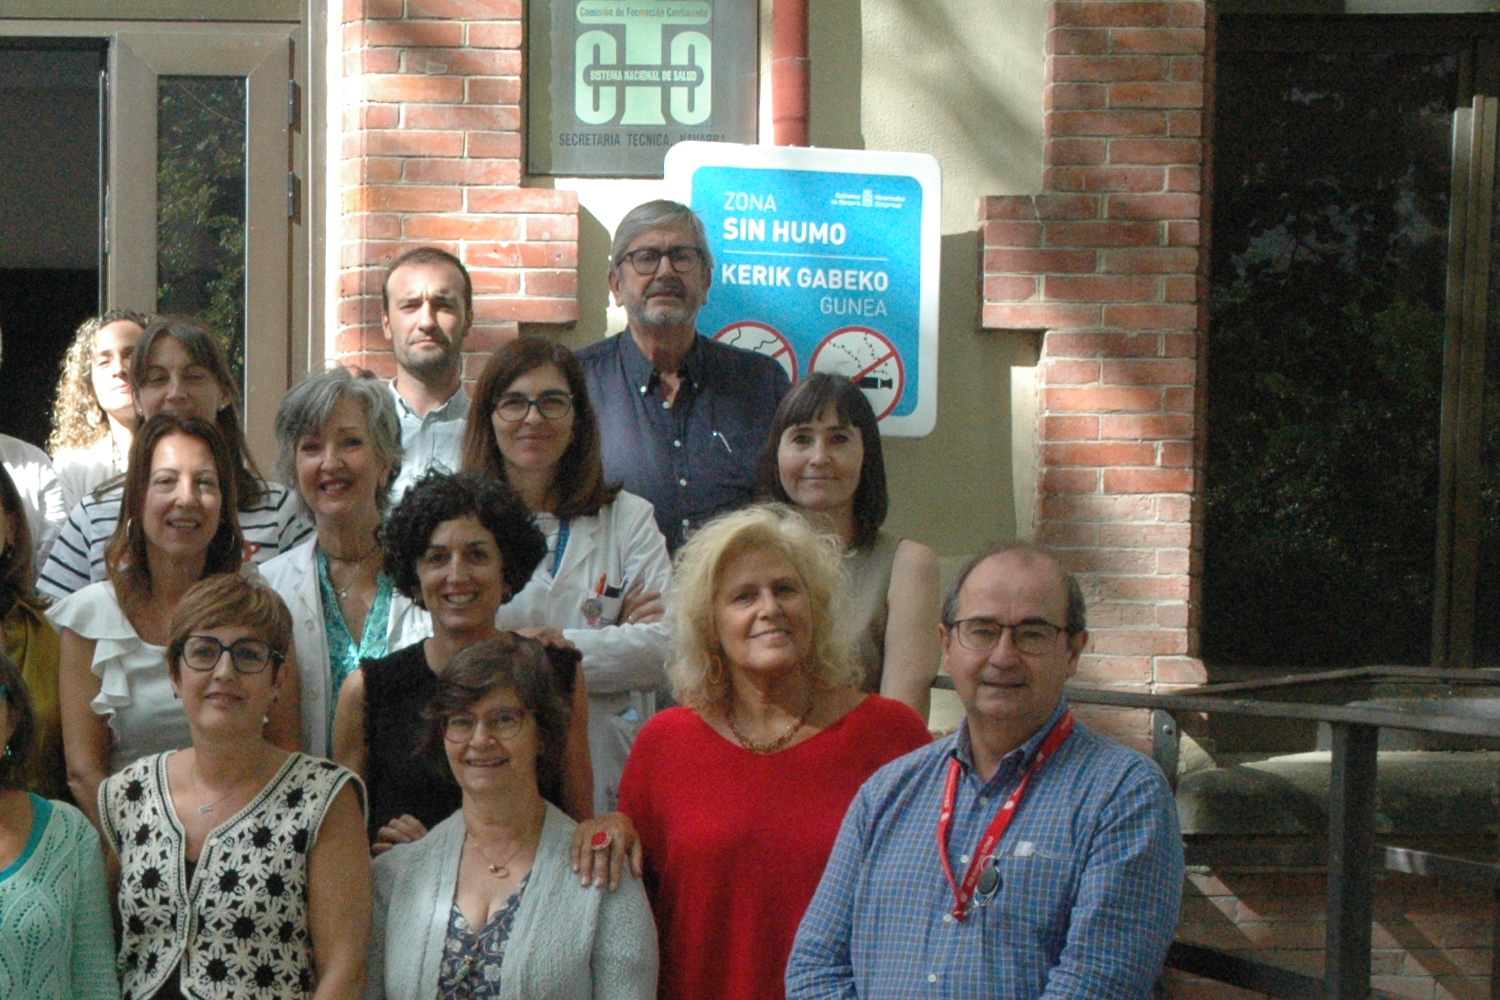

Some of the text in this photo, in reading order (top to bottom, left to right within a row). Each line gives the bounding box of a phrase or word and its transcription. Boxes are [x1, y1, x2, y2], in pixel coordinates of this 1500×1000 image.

[589, 70, 697, 81] SISTEMA NACIONAL DE SALUD
[559, 133, 620, 147] SECRETARIA
[723, 191, 777, 212] ZONA
[722, 217, 847, 245] SIN HUMO
[721, 263, 889, 292] KERIK GABEKO
[820, 297, 888, 316] GUNEA
